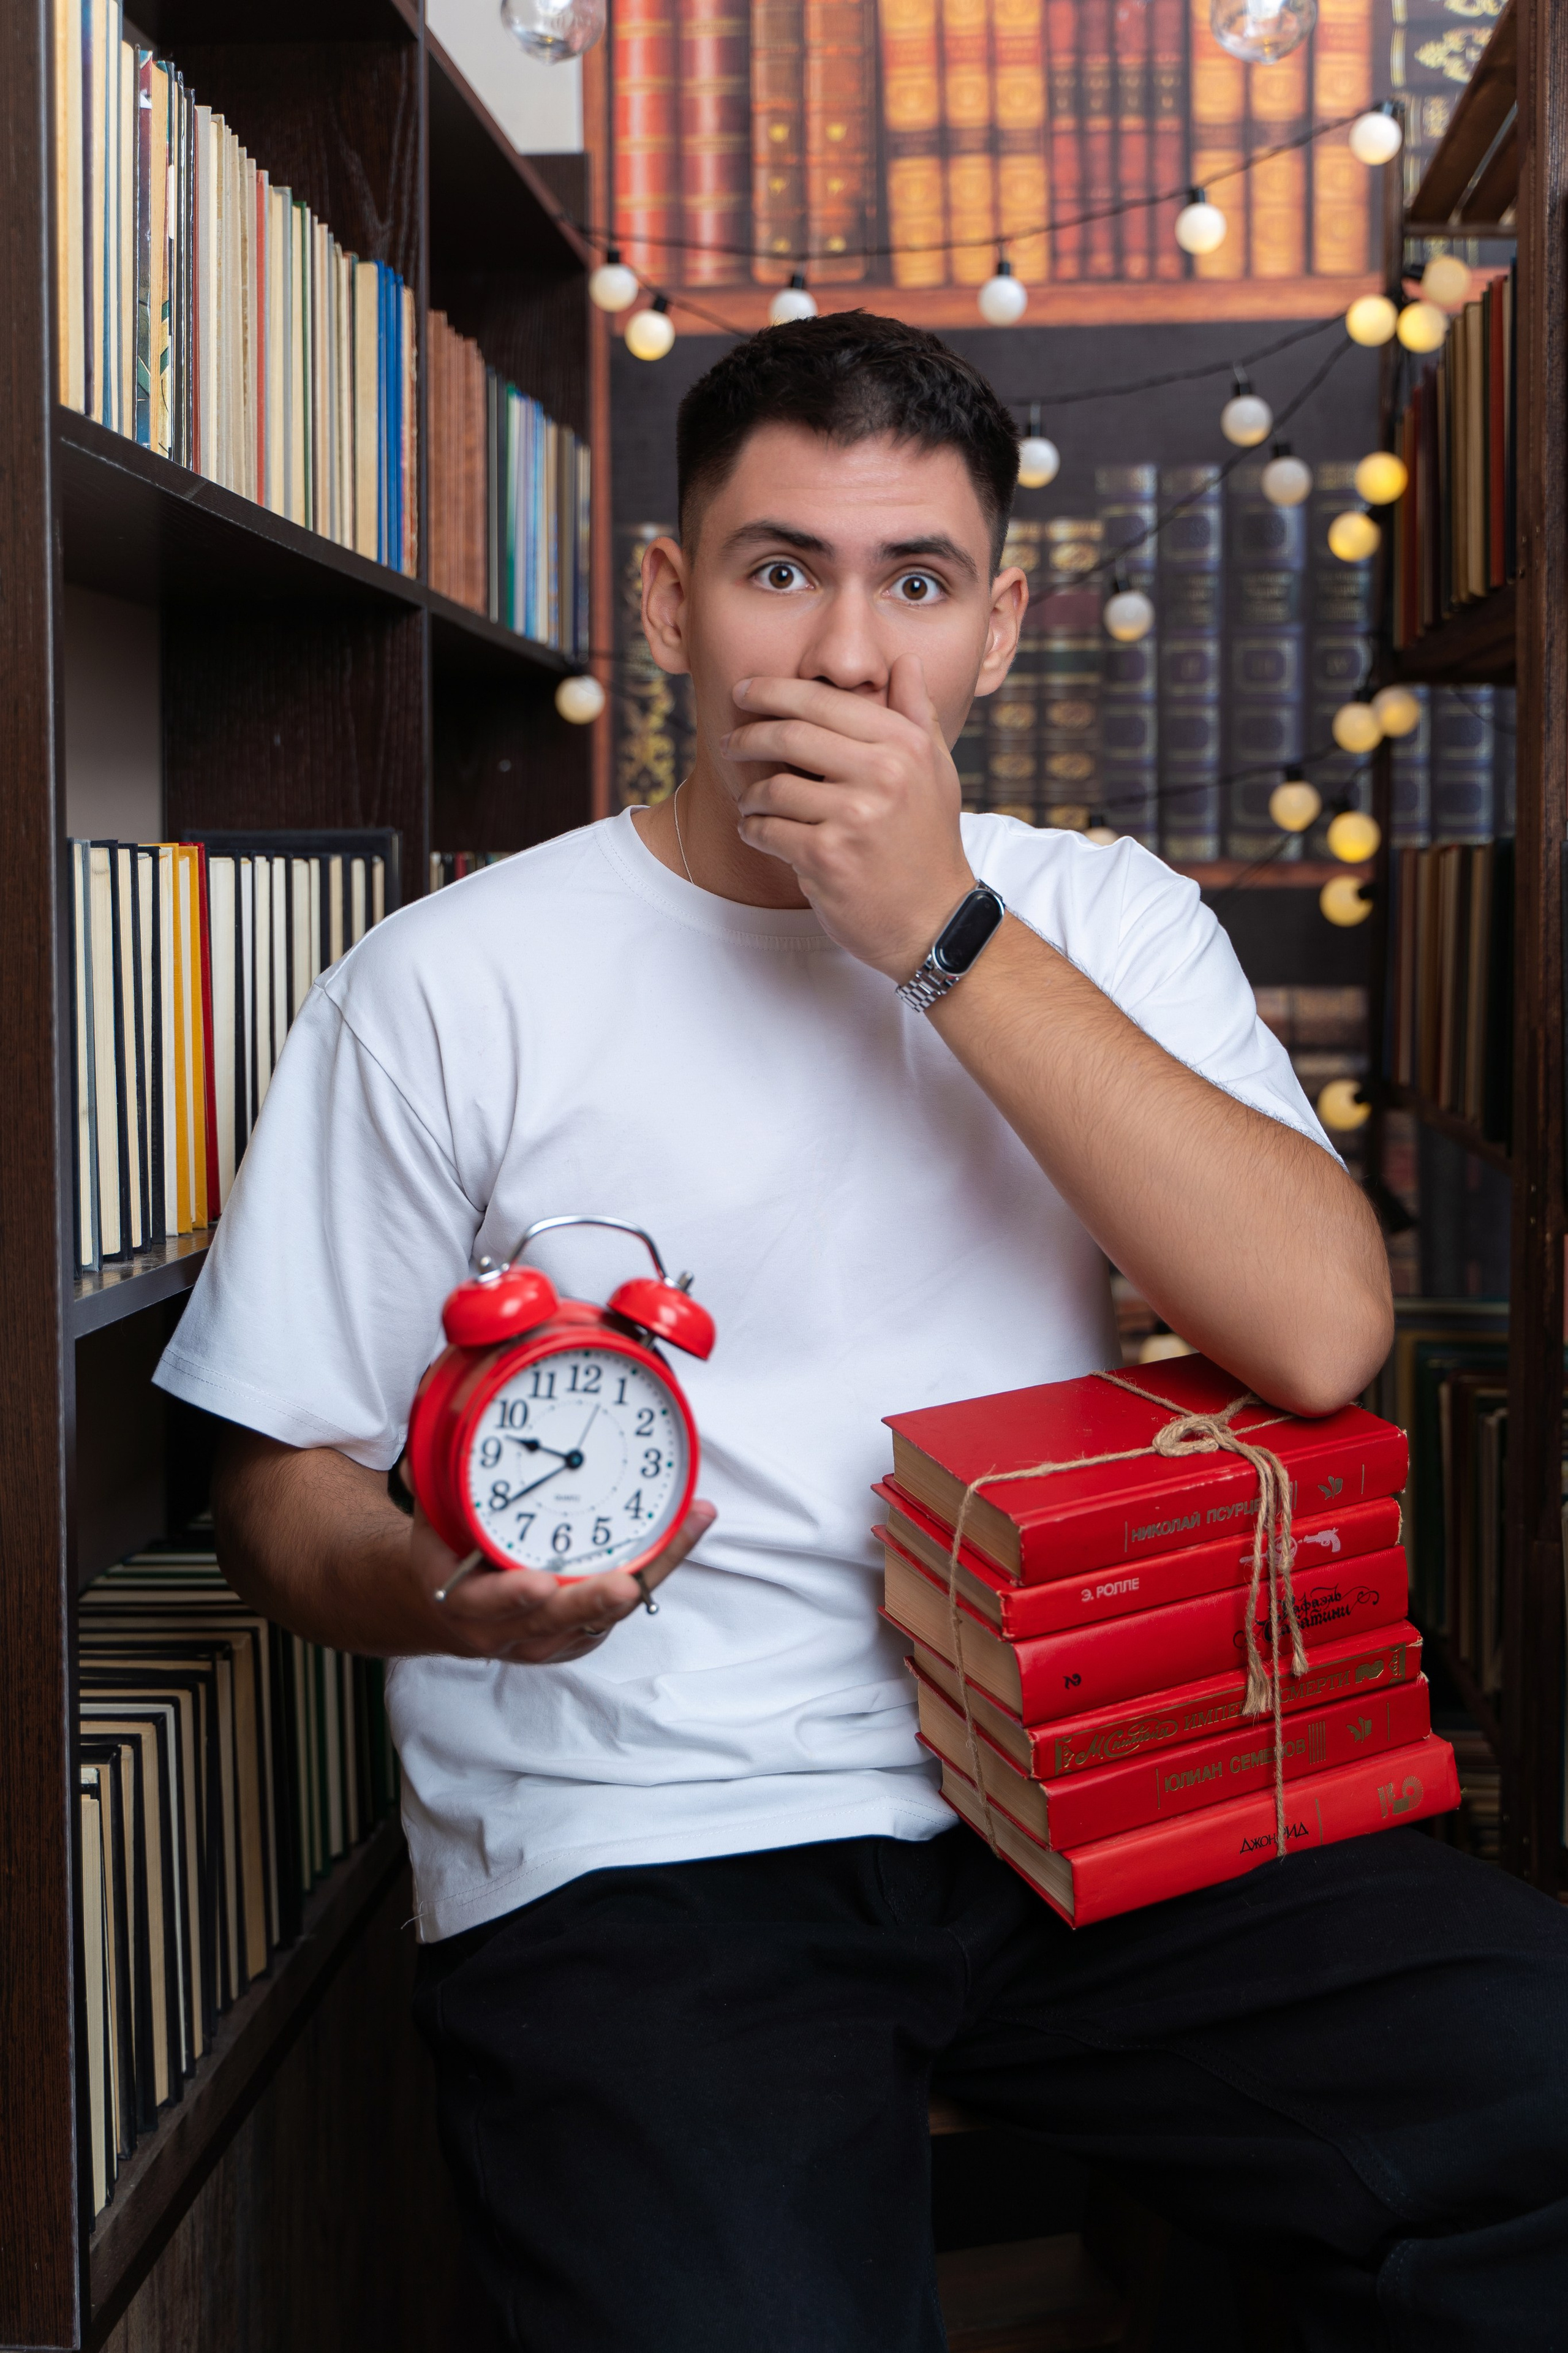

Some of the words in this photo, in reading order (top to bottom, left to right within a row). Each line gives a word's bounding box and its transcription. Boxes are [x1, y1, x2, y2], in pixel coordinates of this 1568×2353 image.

[528, 1370, 558, 1400] 11
[565, 1364, 604, 1394] 12
[614, 1377, 629, 1406] 1
[495, 1399, 529, 1430] 10
[635, 1408, 655, 1437] 2
[480, 1436, 502, 1468] 9
[641, 1448, 662, 1479] 3
[488, 1480, 511, 1512] 8
[624, 1488, 644, 1520] 4
[515, 1513, 537, 1543] 7
[592, 1516, 612, 1546] 5
[1131, 1511, 1201, 1543] НИКОЛАЙ
[1206, 1497, 1264, 1524] ПСУРЦЕ
[552, 1523, 573, 1554] 6
[1080, 1588, 1095, 1603] Э.
[1096, 1577, 1140, 1599] РОЛЛЕ
[1256, 1603, 1352, 1643] Саатини
[1062, 1672, 1082, 1690] 2
[1278, 1670, 1351, 1704] СМЕРТИ
[1164, 1761, 1223, 1793] ЮЛИАН
[1280, 1821, 1310, 1840] ИД
